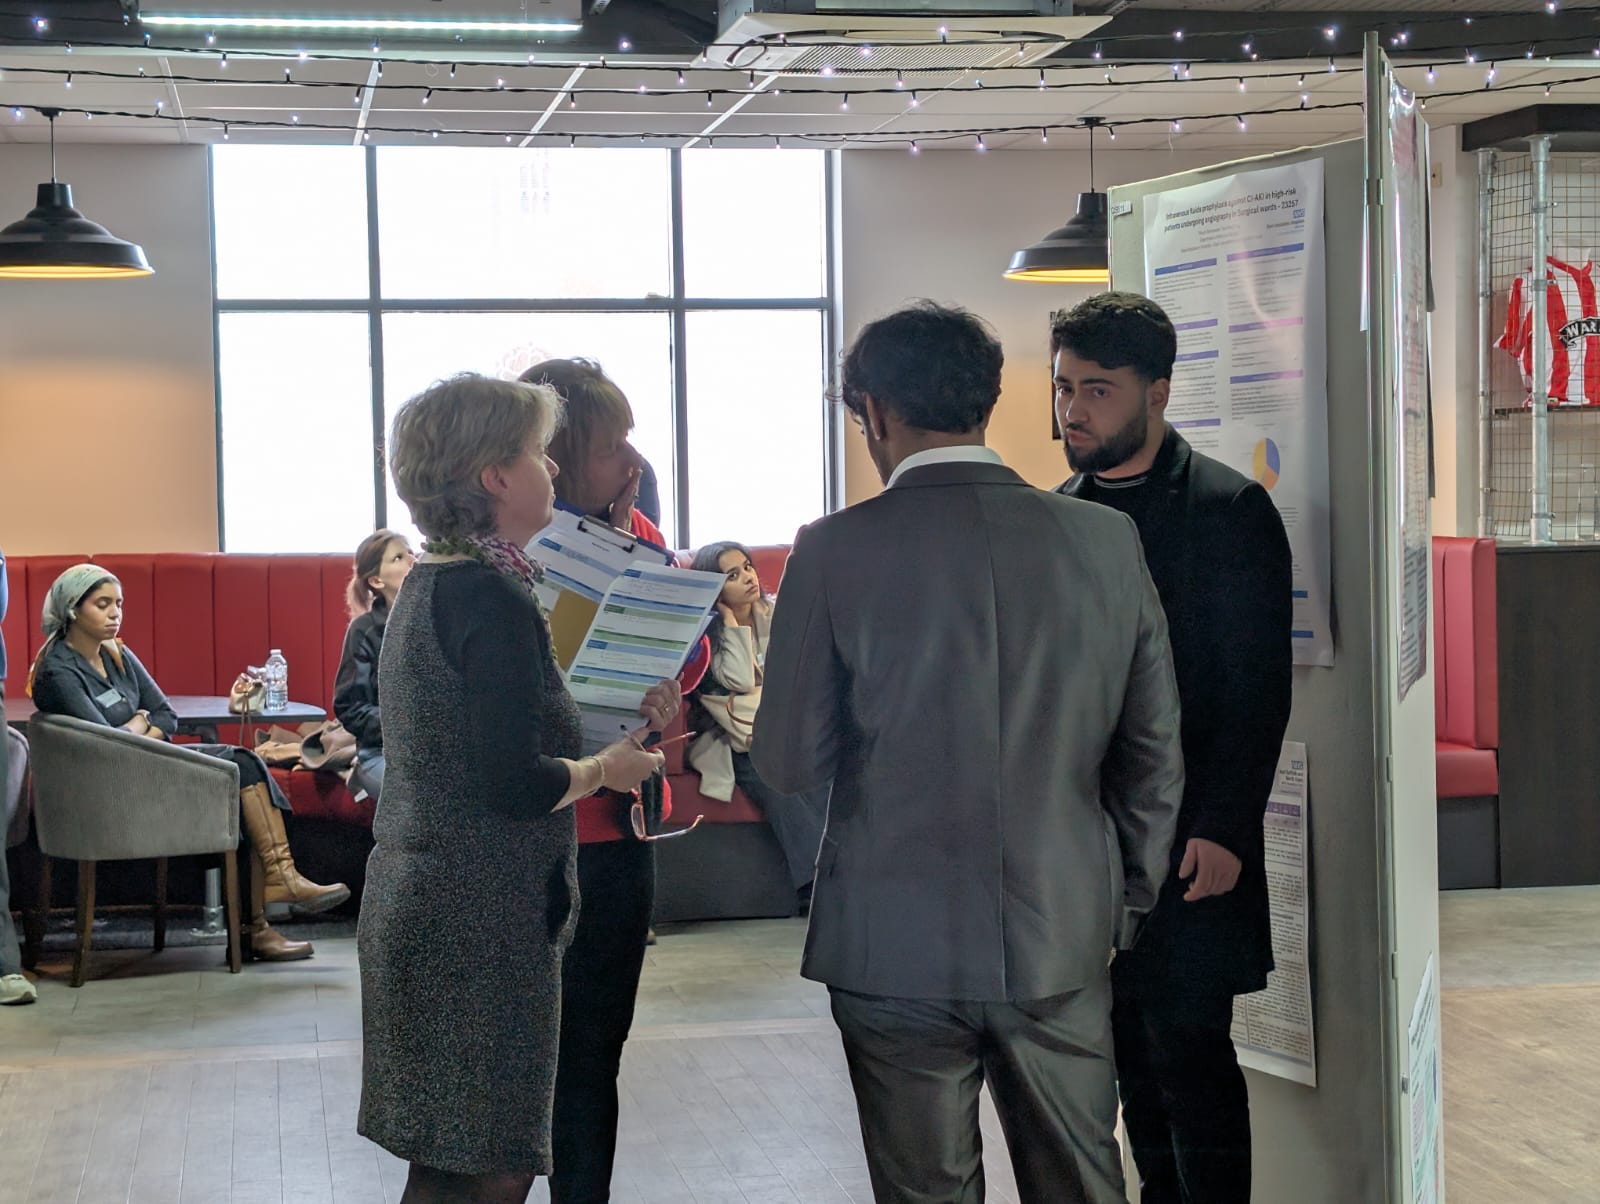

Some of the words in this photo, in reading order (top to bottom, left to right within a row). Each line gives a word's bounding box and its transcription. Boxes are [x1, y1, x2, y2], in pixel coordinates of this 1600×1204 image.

[1190, 205, 1202, 214] fluids
[1271, 187, 1297, 200] high-risk
[1164, 222, 1181, 232] patients
[1181, 217, 1205, 229] undergoing
[1205, 212, 1231, 224] angiography
[1260, 203, 1277, 213] wards
[1566, 320, 1600, 338] WAR
